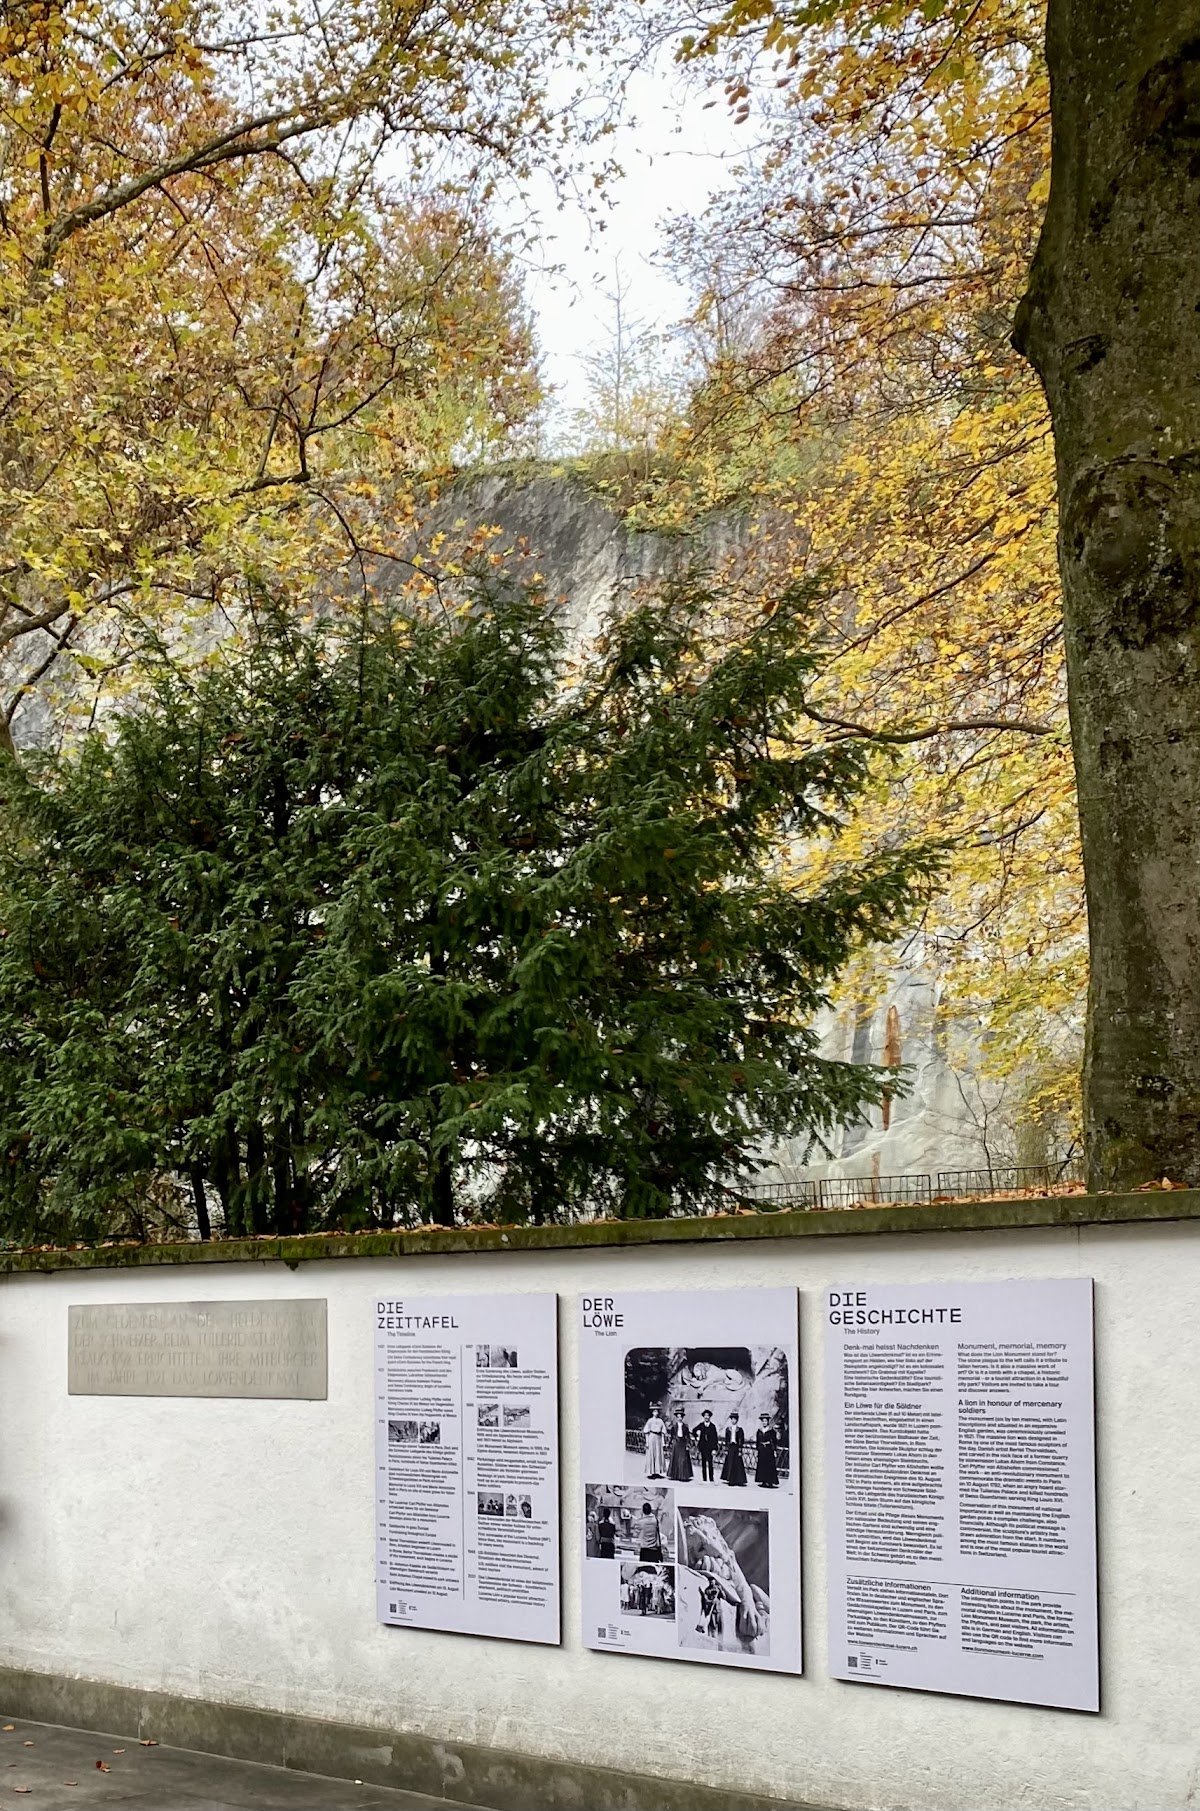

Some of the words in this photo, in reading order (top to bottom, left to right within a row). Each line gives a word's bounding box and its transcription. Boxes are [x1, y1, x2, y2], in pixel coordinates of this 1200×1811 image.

[582, 1298, 614, 1311] DER
[830, 1292, 867, 1307] DIE
[377, 1302, 404, 1314] DIE
[377, 1316, 459, 1329] ZEITTAFEL
[583, 1312, 624, 1328] LÖWE
[829, 1308, 962, 1325] GESCHICHTE
[856, 1327, 880, 1335] History
[957, 1342, 997, 1350] Monument,
[998, 1342, 1034, 1350] memorial,
[846, 1578, 883, 1586] Zusätzliche
[884, 1581, 931, 1590] Informationen
[960, 1587, 996, 1596] Additional
[997, 1590, 1039, 1600] information
